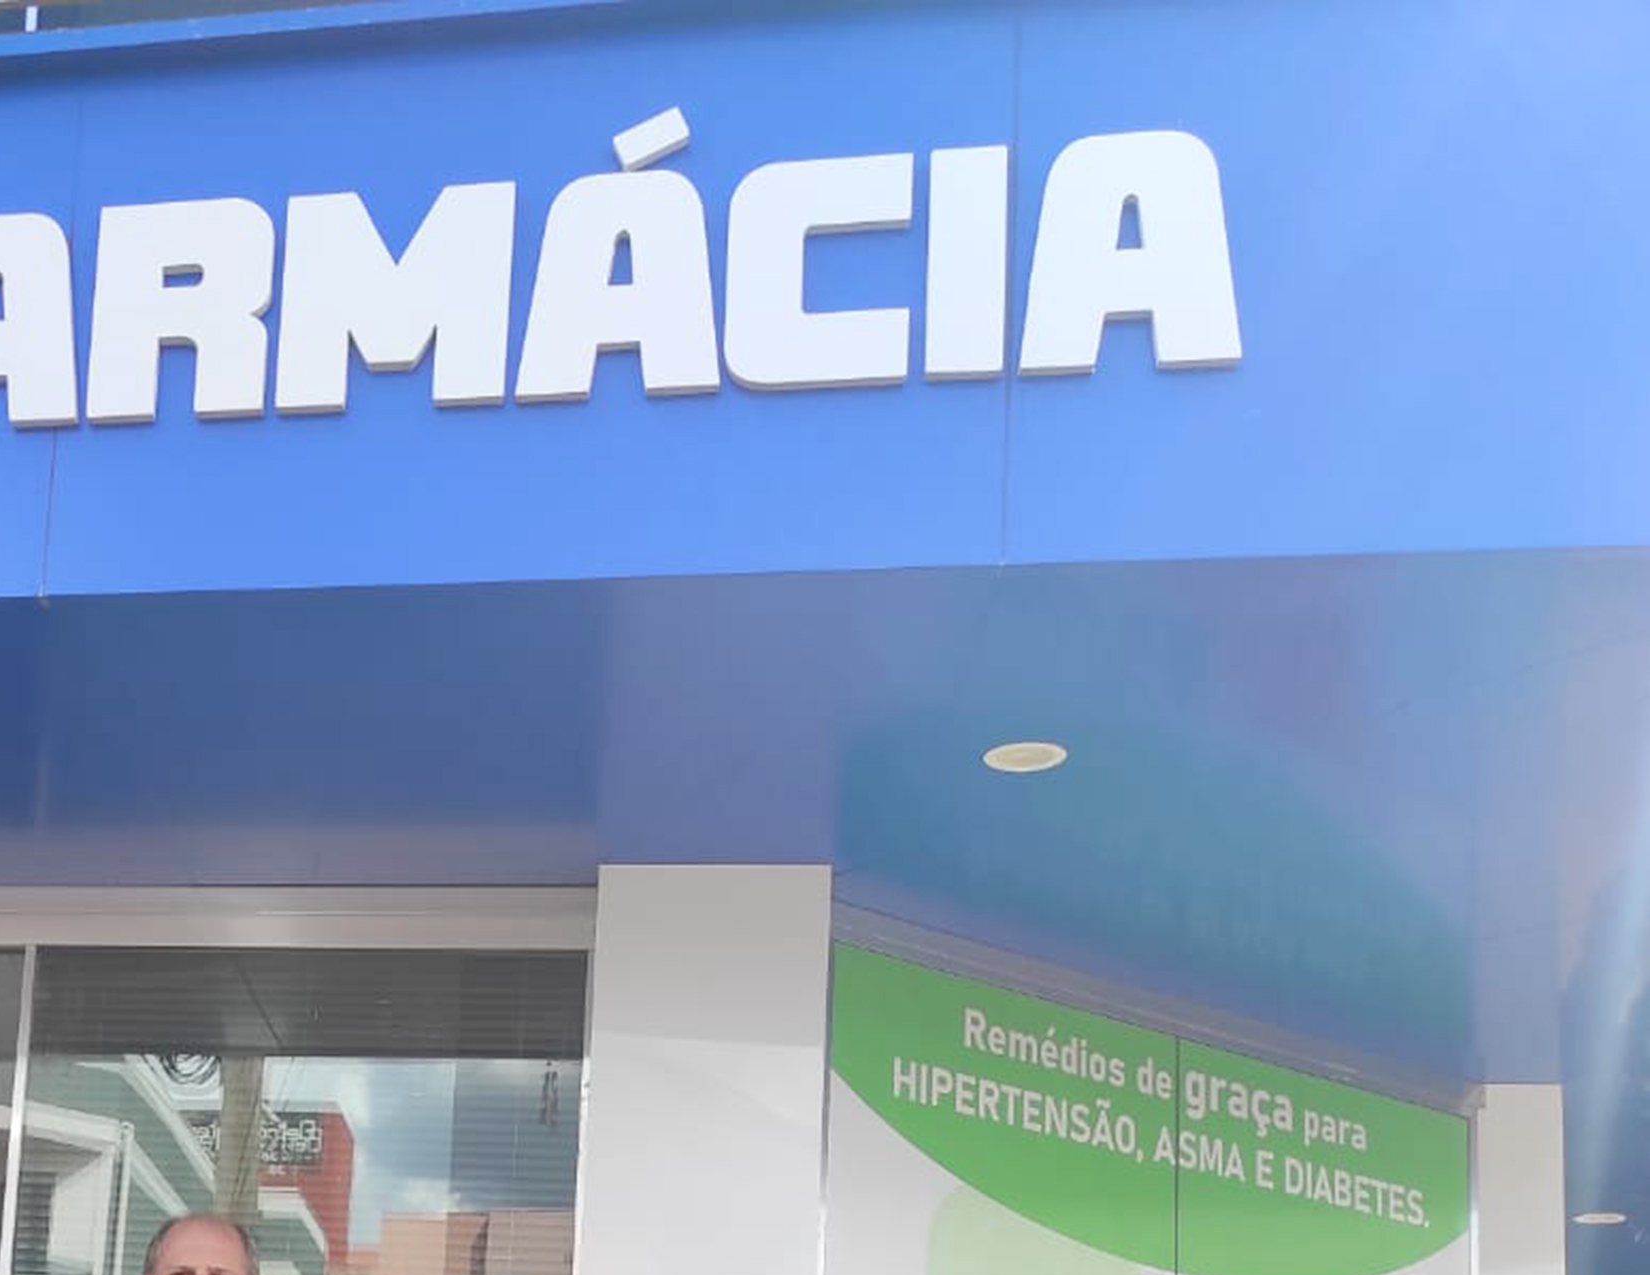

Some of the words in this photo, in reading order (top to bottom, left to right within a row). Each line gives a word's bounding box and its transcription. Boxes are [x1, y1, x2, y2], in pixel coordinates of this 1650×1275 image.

[893, 1056, 1144, 1164] HIPERTENSÃO,
[1153, 1126, 1245, 1183] ASMA
[1255, 1149, 1275, 1190] E
[1284, 1156, 1431, 1229] DIABETES.
[963, 1007, 1126, 1087] Remédios
[1136, 1056, 1173, 1099] de
[1184, 1069, 1294, 1138] graça
[1303, 1107, 1368, 1152] para
